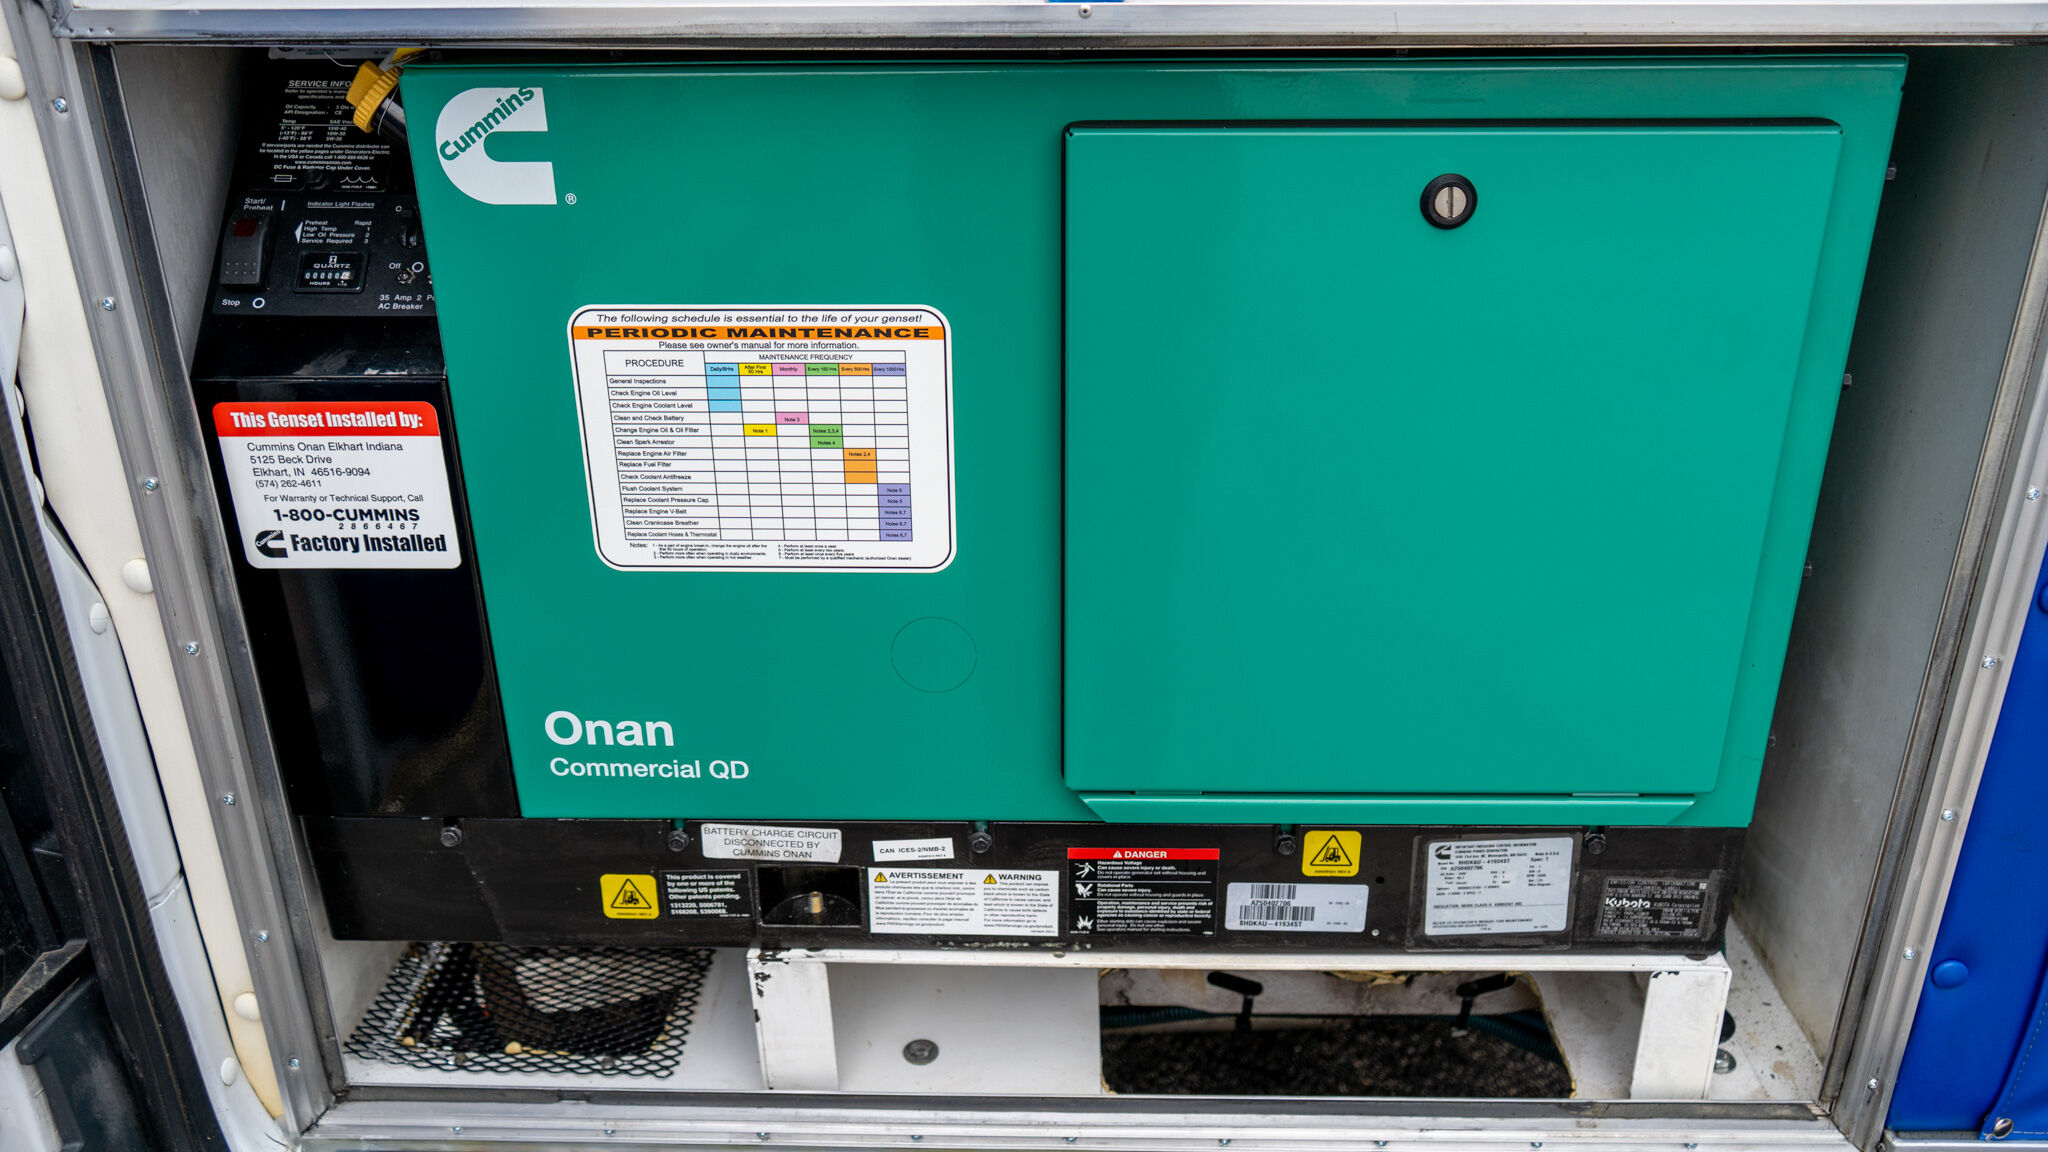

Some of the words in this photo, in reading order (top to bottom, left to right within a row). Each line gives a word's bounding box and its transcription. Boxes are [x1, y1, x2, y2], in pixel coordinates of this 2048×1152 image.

[439, 87, 534, 161] Cummins
[222, 299, 240, 307] Stop
[394, 294, 412, 302] Amp
[597, 314, 617, 322] The
[621, 314, 668, 324] following
[672, 314, 720, 322] schedule
[724, 314, 732, 322] is
[822, 314, 837, 322] life
[841, 314, 853, 322] of
[854, 316, 879, 324] your
[881, 315, 922, 324] genset!
[587, 328, 717, 338] PERIODIC
[727, 327, 930, 339] MAINTENANCE
[659, 341, 687, 349] Please
[707, 341, 739, 349] owner's
[741, 341, 771, 349] manual
[774, 341, 785, 349] for
[811, 341, 859, 349] information.
[625, 359, 684, 367] PROCEDURE
[230, 412, 266, 427] This
[268, 412, 322, 427] Genset
[325, 412, 397, 427] Installed
[399, 412, 423, 428] by:
[247, 442, 295, 451] Cummins
[297, 442, 325, 451] Onan
[328, 442, 364, 451] Elkhart
[366, 442, 403, 451] Indiana
[250, 455, 275, 464] 5125
[278, 455, 303, 464] Beck
[306, 455, 332, 463] Drive
[253, 468, 291, 477] Elkhart,
[294, 468, 305, 476] IN
[311, 468, 370, 476] 46516-9094
[256, 480, 278, 489] (574)
[279, 495, 317, 503] Warranty
[329, 494, 369, 502] Technical
[371, 494, 405, 503] Support,
[407, 494, 423, 502] Call
[273, 509, 420, 521] 1-800-CUMMINS
[255, 530, 281, 547] Cummins
[290, 534, 359, 553] Factory
[364, 534, 447, 552] Installed
[545, 711, 674, 746] Onan
[550, 757, 701, 778] Commercial
[709, 760, 749, 780] QD
[704, 827, 749, 836] BATTERY
[751, 829, 794, 838] CHARGE
[797, 830, 838, 839] CIRCUIT
[724, 838, 805, 848] DISCONNECTED
[732, 849, 780, 857] CUMMINS
[783, 850, 812, 858] ONAN
[889, 872, 964, 880] AVERTISSEMENT
[1606, 898, 1650, 908] Kubota
